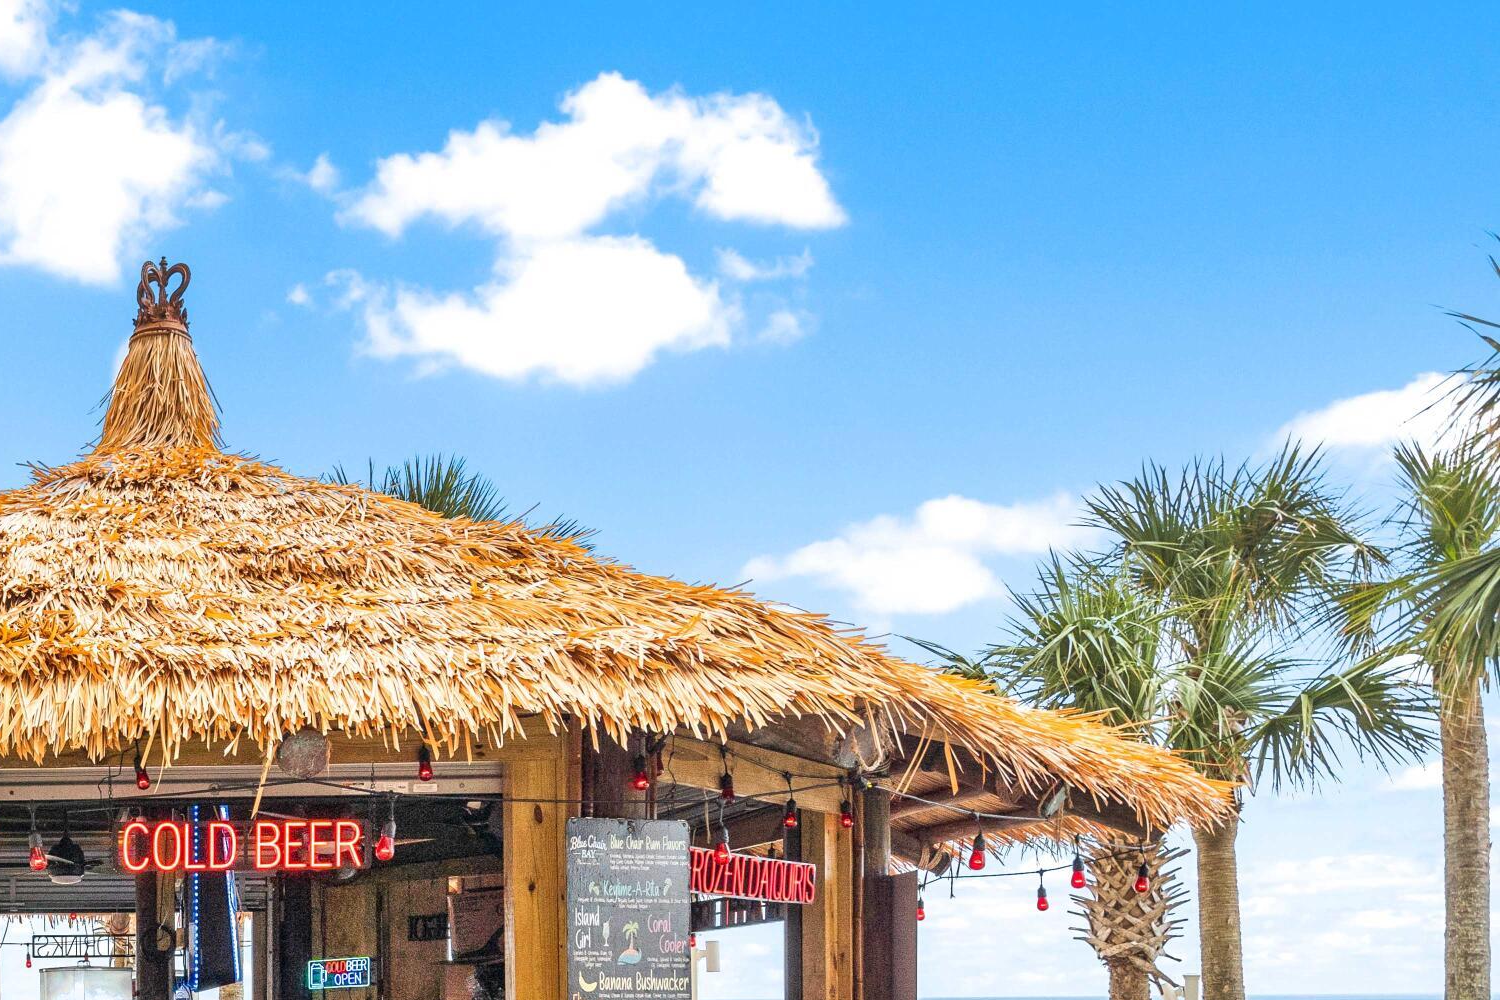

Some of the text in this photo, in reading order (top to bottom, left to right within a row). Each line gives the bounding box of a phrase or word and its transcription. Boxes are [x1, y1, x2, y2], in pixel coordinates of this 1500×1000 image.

[122, 821, 362, 870] COLD BEER
[570, 835, 587, 850] Blue
[611, 835, 685, 850] Blue Chair Rum Flavors
[582, 850, 596, 858] BAY
[692, 849, 816, 903] ROZEN DAIQUIRIS
[575, 905, 599, 926] Island
[648, 913, 671, 933] Coral
[576, 929, 591, 949] Girl
[659, 933, 687, 953] Cooler
[326, 959, 367, 973] COLD BEER
[335, 973, 362, 985] OPEN
[599, 969, 689, 991] Banana Bushwacker
